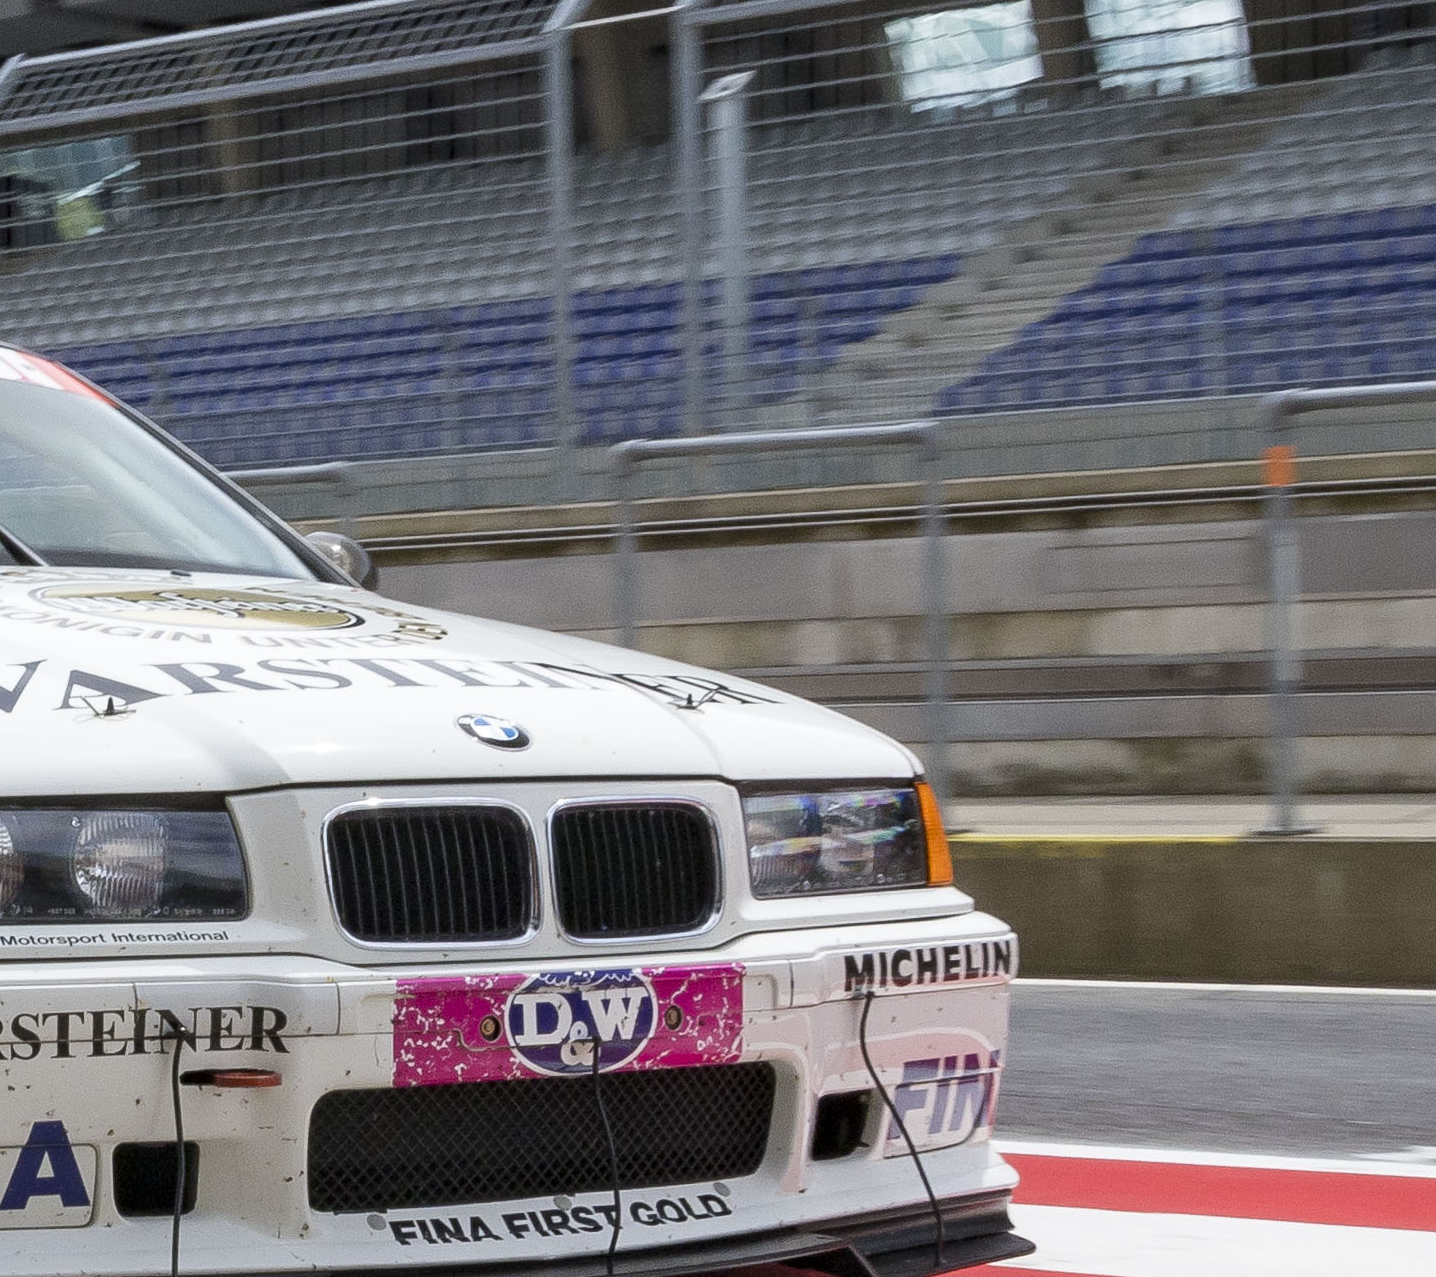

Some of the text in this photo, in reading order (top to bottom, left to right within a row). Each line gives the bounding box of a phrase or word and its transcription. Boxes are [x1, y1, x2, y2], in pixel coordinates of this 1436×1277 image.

[0, 932, 105, 948] Motorsport
[112, 930, 229, 944] International
[844, 940, 1011, 992] MICHELIN
[388, 1193, 733, 1246] FINA FIRST GOLD
